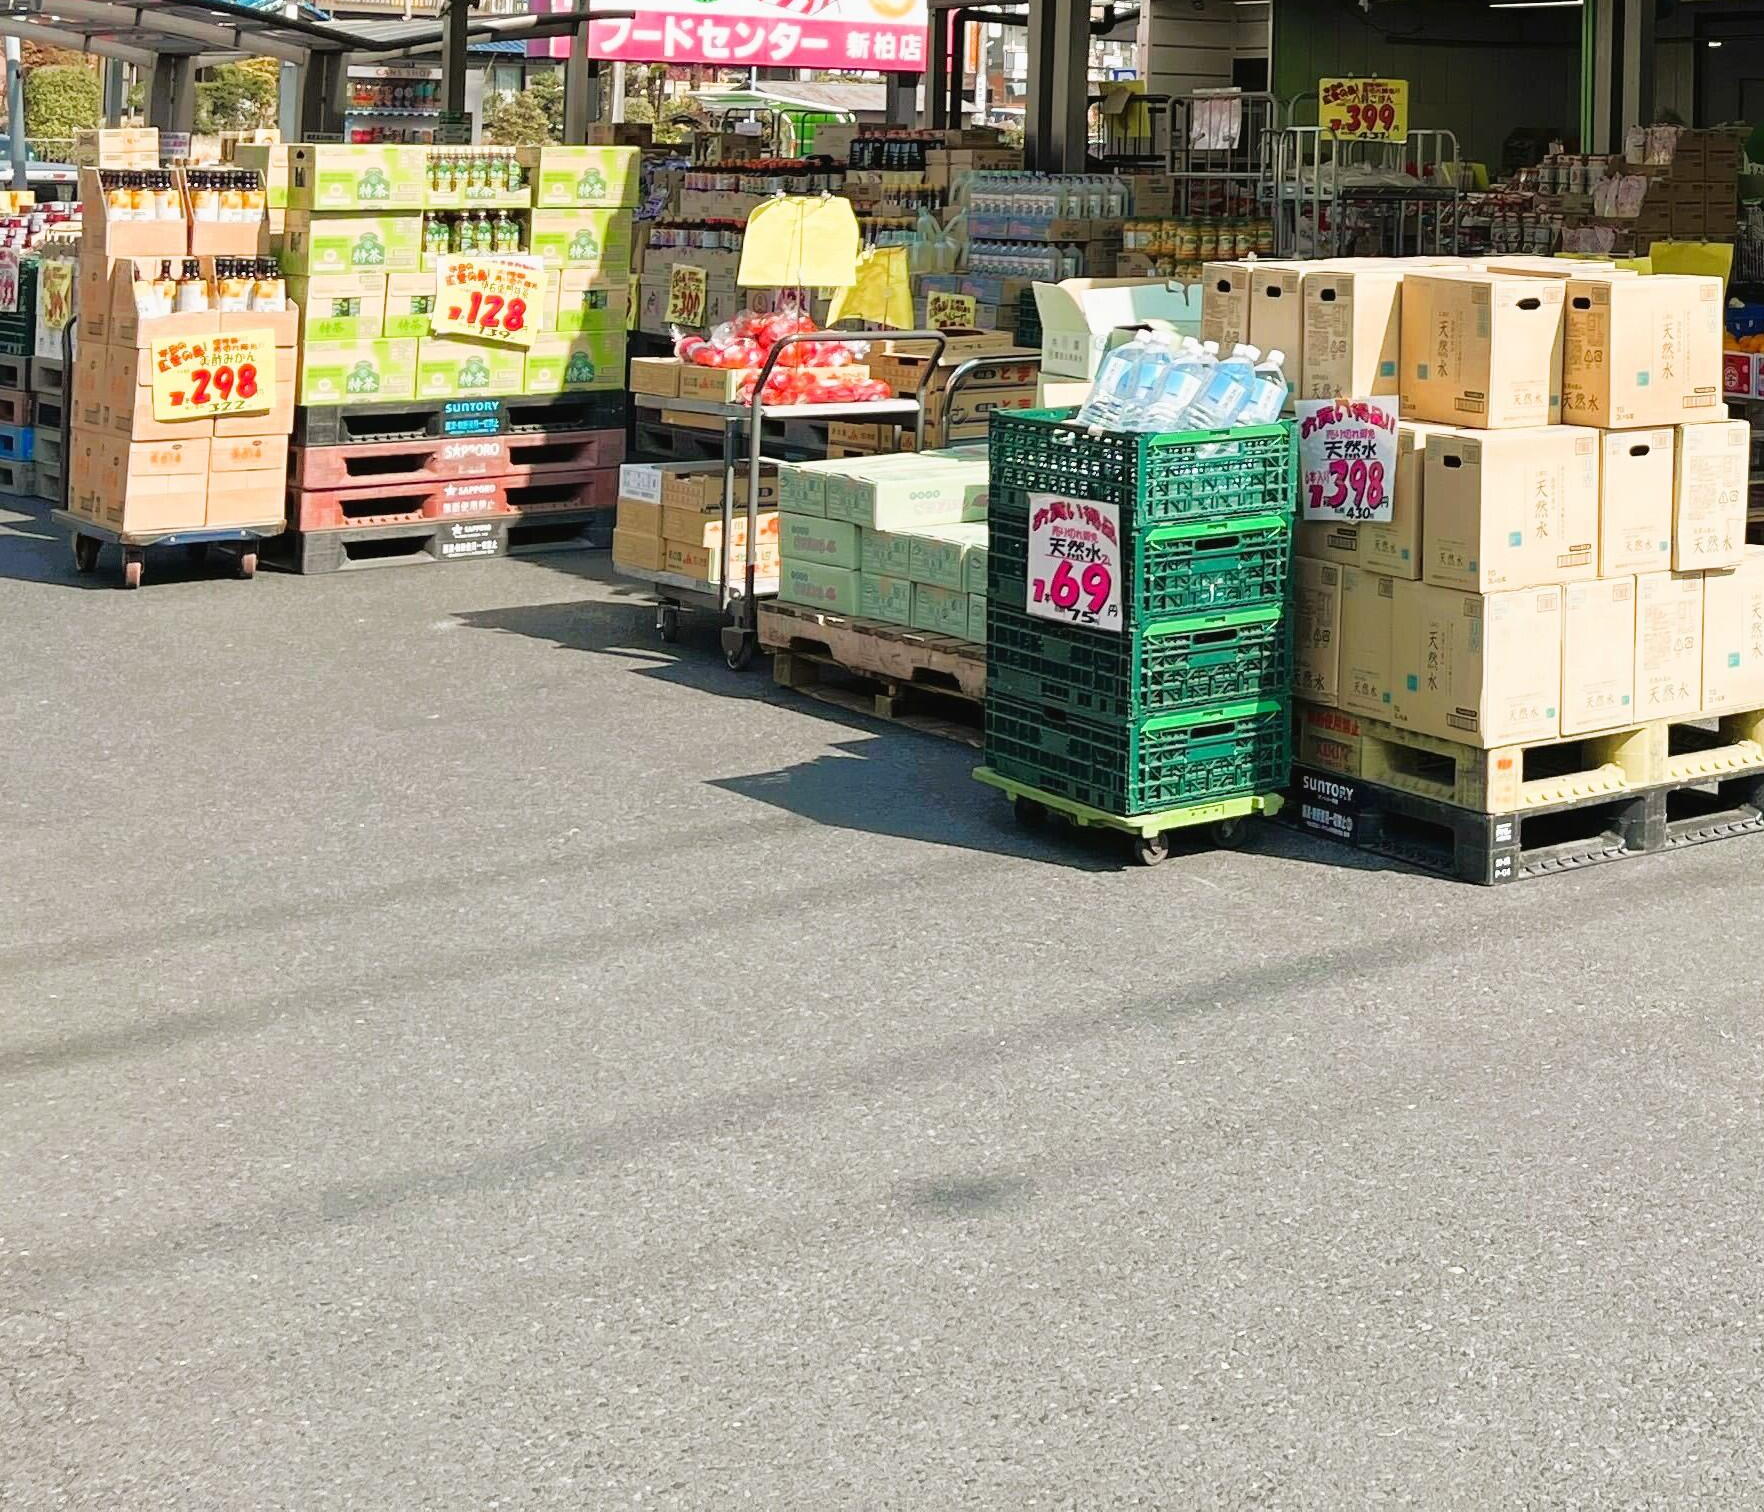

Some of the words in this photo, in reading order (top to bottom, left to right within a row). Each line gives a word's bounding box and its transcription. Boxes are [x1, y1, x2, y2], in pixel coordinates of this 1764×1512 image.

[600, 16, 829, 62] フードセンター
[846, 31, 922, 62] 新柏店
[1345, 104, 1396, 133] 399
[466, 291, 527, 332] 128
[191, 363, 258, 406] 298
[445, 400, 500, 414] SUNTORY
[1323, 440, 1377, 460] 天然水
[1327, 458, 1386, 511] 398
[1345, 506, 1371, 520] 430
[1049, 537, 1101, 563] 天然水
[1050, 558, 1113, 616] 69
[1067, 608, 1095, 624] 75
[1303, 775, 1355, 802] SUNTORY
